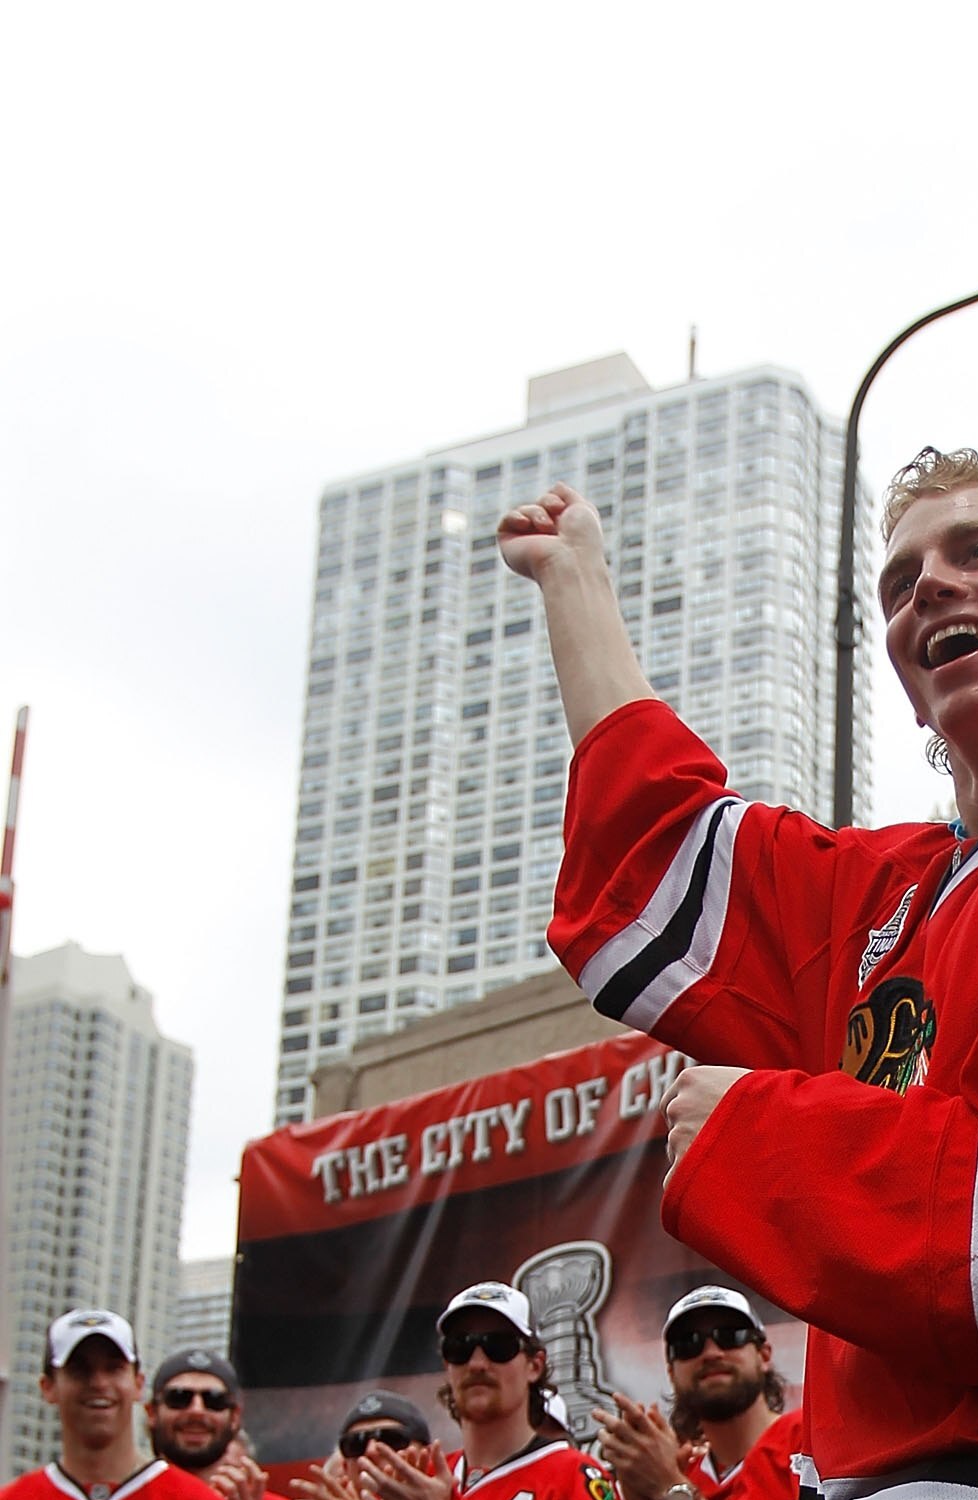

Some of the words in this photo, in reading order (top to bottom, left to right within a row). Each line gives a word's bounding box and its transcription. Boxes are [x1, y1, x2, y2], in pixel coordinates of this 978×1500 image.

[311, 1133, 409, 1203] THE
[420, 1097, 532, 1177] CITY
[544, 1075, 609, 1142] OF
[619, 1049, 697, 1119] CH
